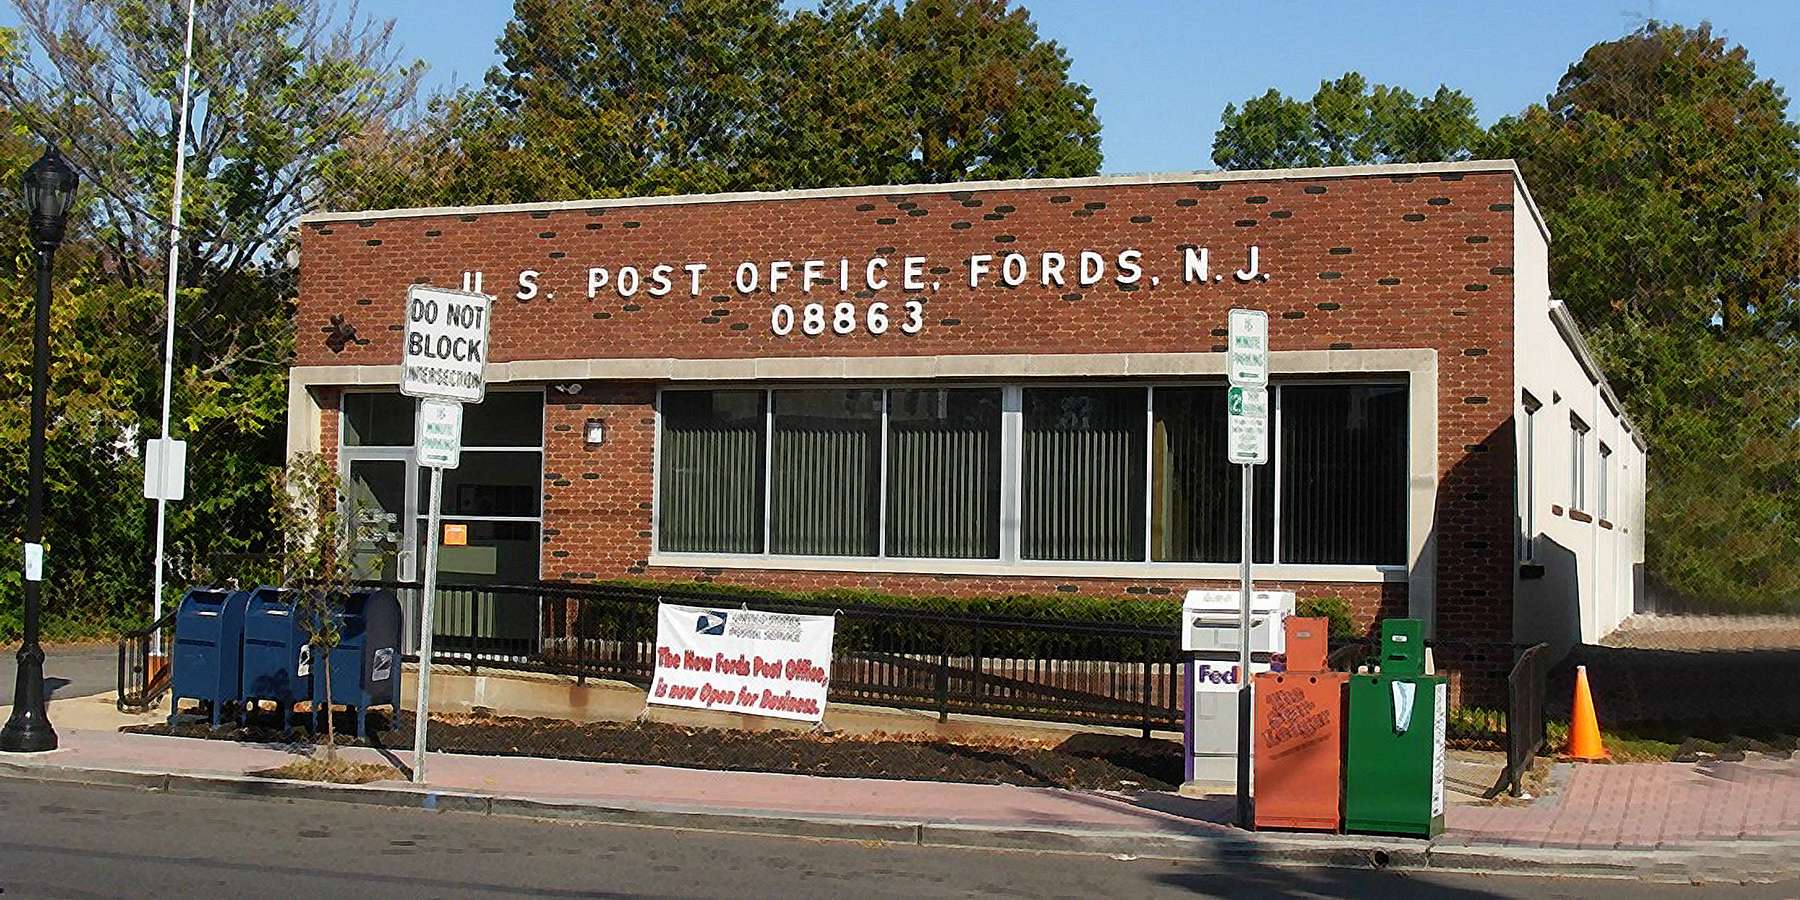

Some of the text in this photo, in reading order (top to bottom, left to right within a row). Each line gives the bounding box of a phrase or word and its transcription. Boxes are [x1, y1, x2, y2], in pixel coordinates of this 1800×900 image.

[588, 264, 708, 299] POST
[736, 257, 940, 295] OFFICE,
[970, 250, 1160, 287] FORDS,
[411, 298, 484, 329] DO NOT
[771, 301, 924, 336] 08863
[408, 331, 482, 363] BLOCK
[407, 366, 482, 389] INTERSECTION
[657, 646, 681, 669] The
[684, 650, 713, 672] New
[715, 652, 751, 677] Fords
[753, 655, 783, 679] Post
[654, 677, 667, 698] is
[669, 684, 699, 701] now
[700, 682, 736, 708] Open
[738, 684, 759, 707] for
